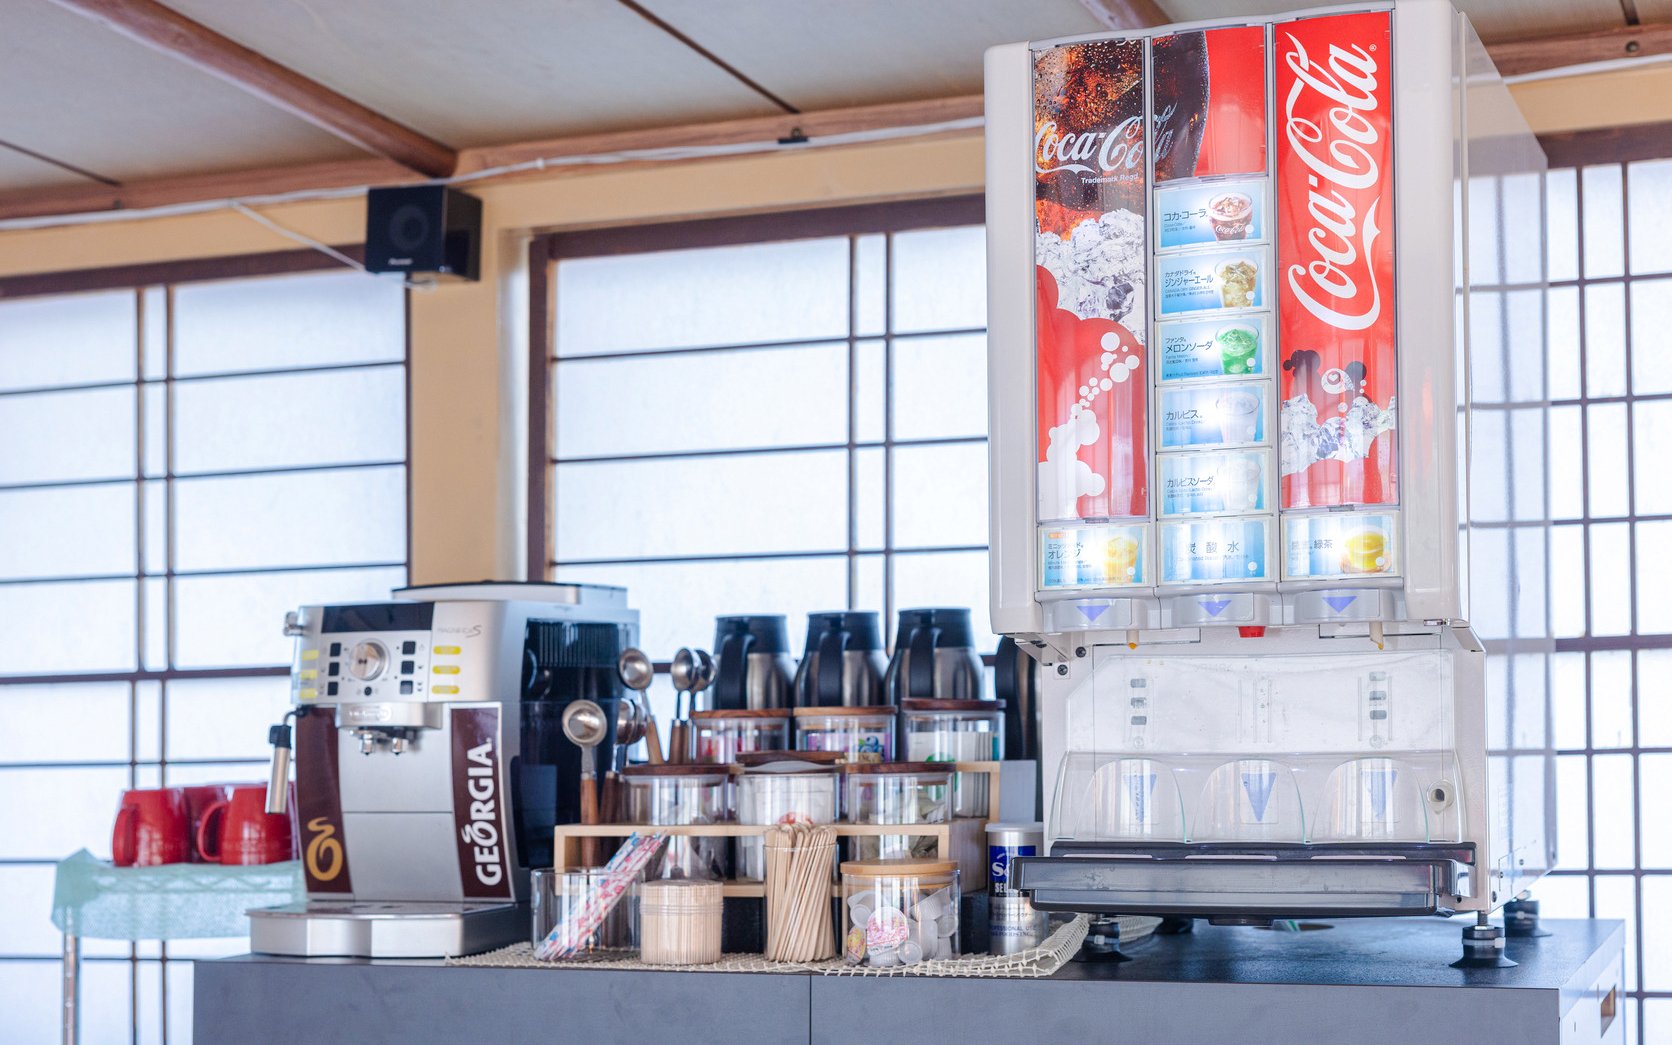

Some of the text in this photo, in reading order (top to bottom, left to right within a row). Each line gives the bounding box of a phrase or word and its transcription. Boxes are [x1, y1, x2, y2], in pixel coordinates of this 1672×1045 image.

[1081, 174, 1118, 184] Trademark
[1286, 32, 1380, 330] Coca-Cola
[1165, 275, 1213, 287] ジンジャーエール
[1165, 341, 1213, 353] メロンソーダ
[1167, 476, 1214, 488] カルピスソーダ
[462, 741, 502, 886] GEORGIA
